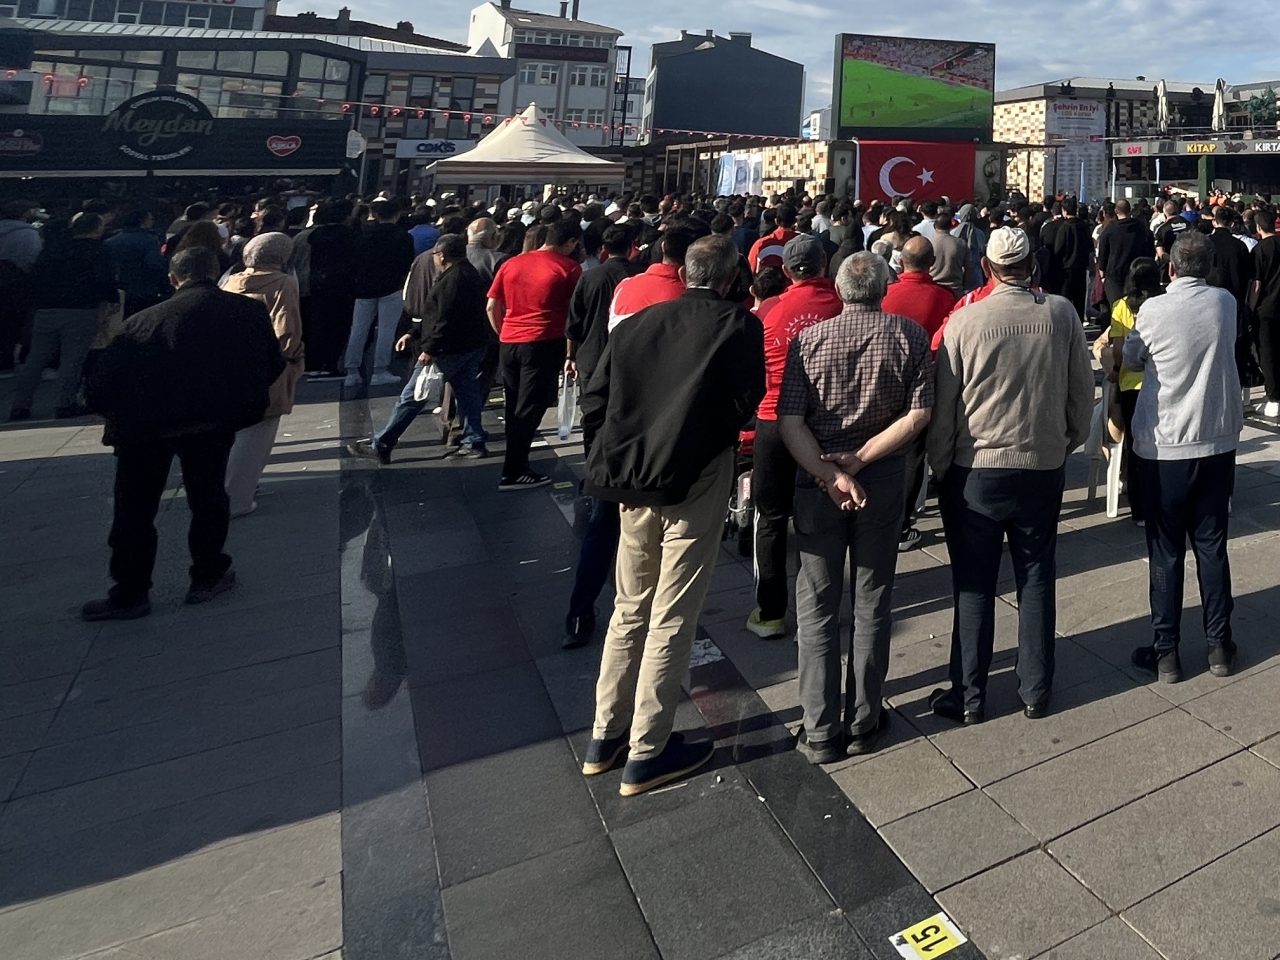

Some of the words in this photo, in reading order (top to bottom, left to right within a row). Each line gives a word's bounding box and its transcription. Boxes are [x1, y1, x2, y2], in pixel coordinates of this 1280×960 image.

[1079, 104, 1089, 112] En
[101, 110, 213, 146] Meydan
[1186, 141, 1217, 153] KİTAP
[911, 924, 948, 952] 15
